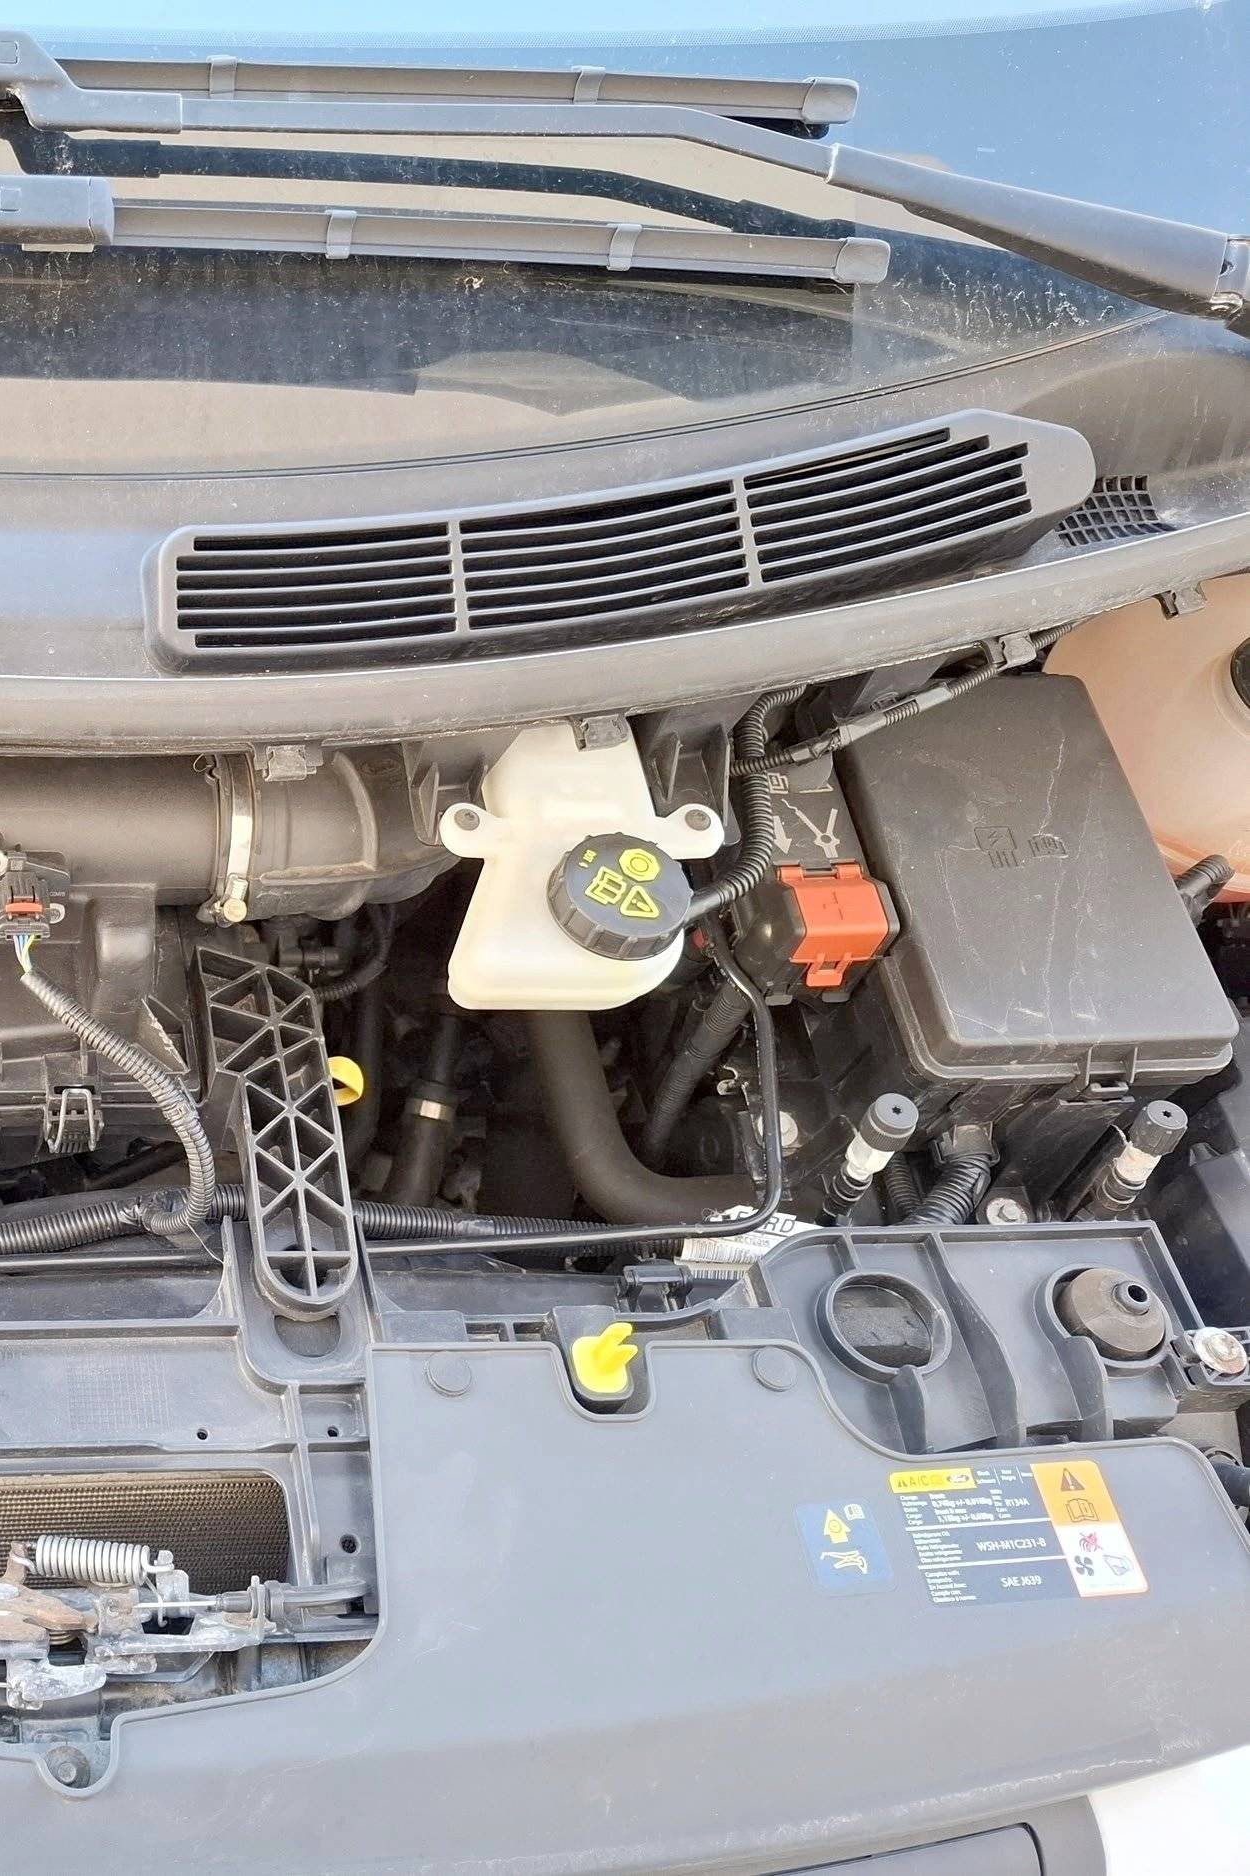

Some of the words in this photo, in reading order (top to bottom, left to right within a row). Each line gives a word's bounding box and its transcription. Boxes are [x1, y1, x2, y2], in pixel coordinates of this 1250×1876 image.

[735, 1210, 796, 1233] FRD
[910, 1475, 929, 1487] A/C
[1000, 1576, 1020, 1588] SAE
